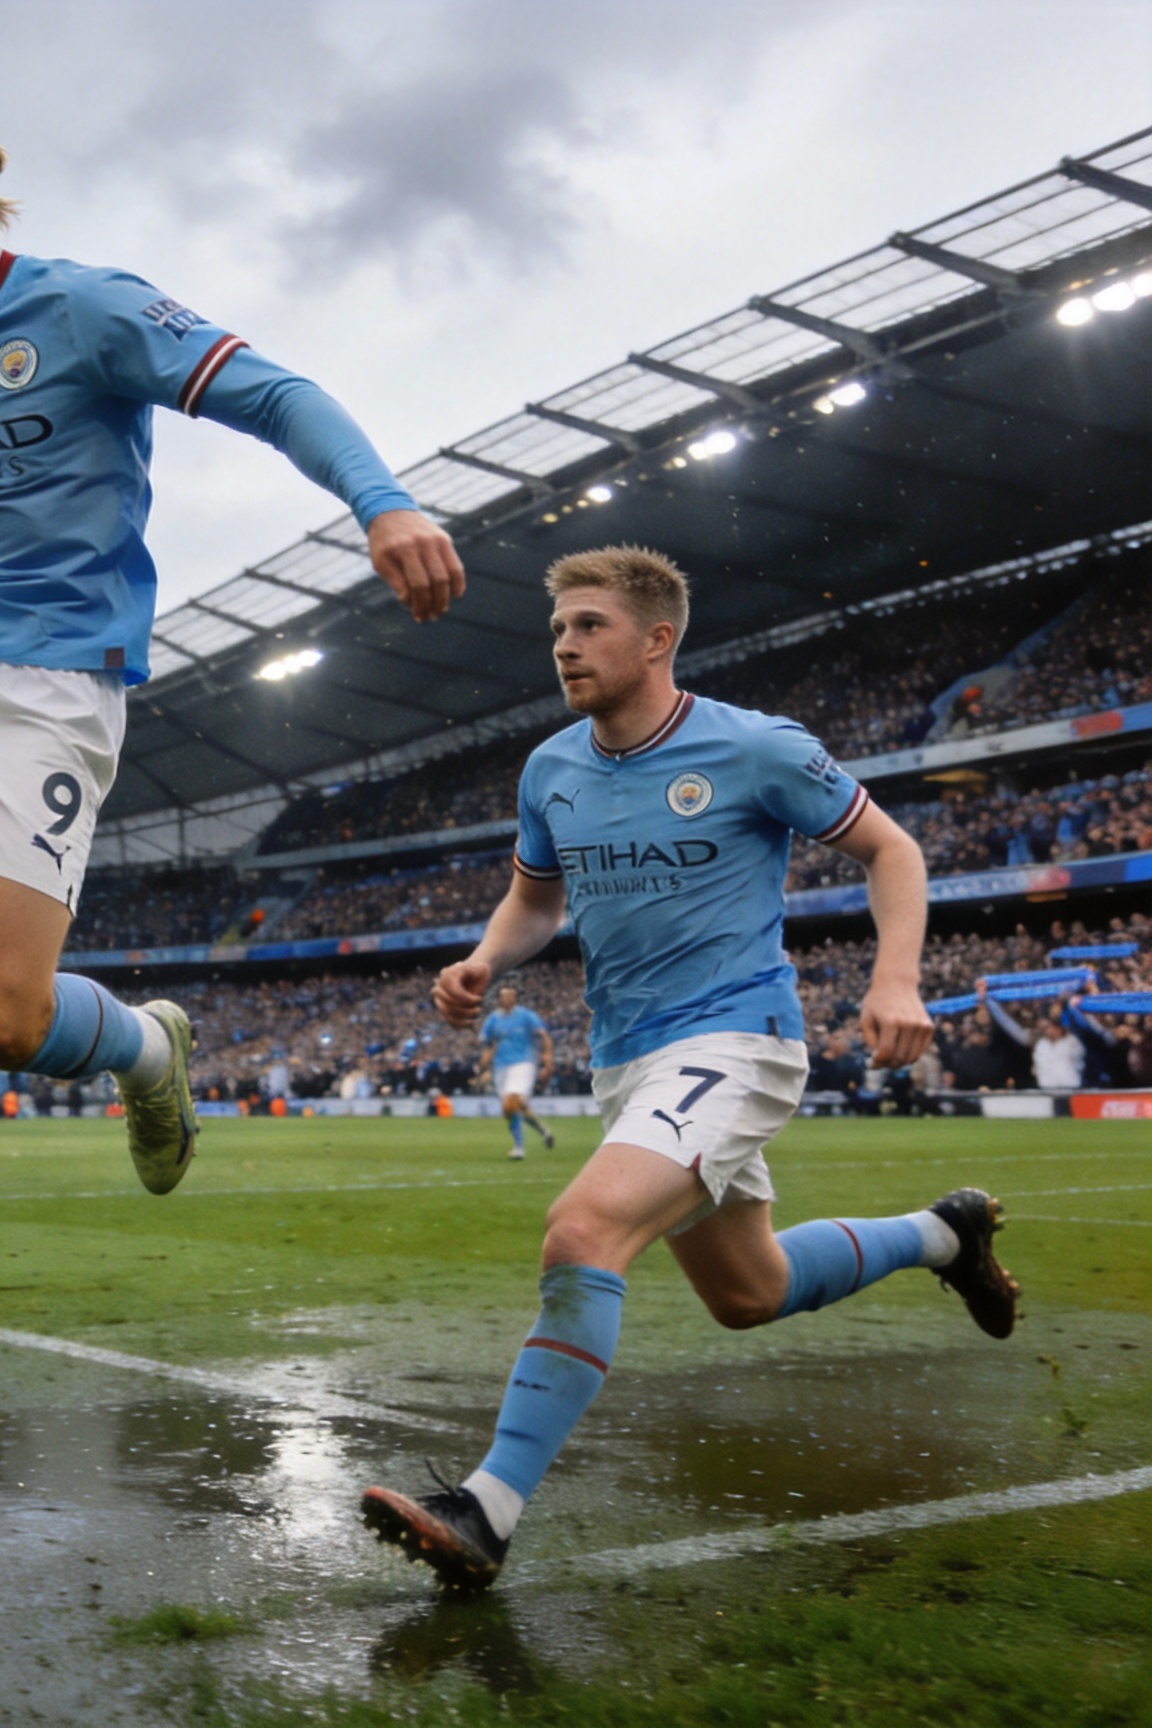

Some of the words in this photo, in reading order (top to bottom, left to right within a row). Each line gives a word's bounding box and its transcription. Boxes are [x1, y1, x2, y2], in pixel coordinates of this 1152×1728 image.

[41, 771, 83, 836] 9
[558, 839, 719, 875] ETIHAD
[674, 1065, 728, 1114] 7
